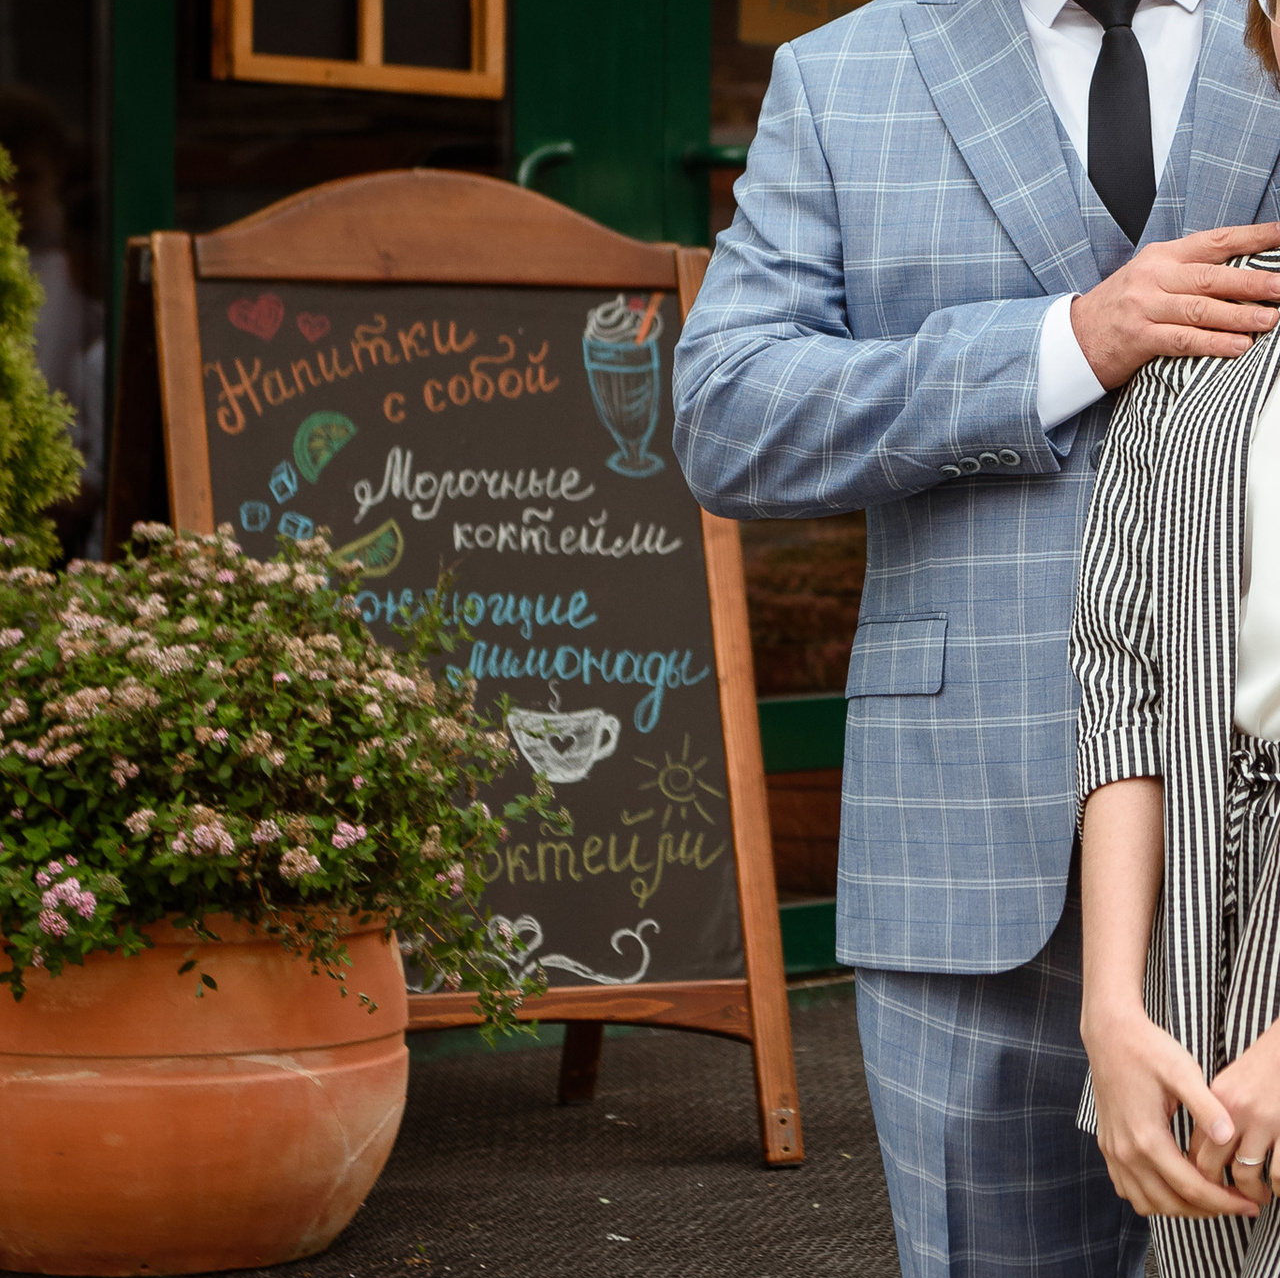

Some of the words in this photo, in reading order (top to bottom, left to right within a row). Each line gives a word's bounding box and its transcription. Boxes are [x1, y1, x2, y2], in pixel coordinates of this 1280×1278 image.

[204, 315, 476, 436] Напитки
[424, 335, 560, 414] собой
[353, 447, 595, 523] Молочные
[453, 507, 683, 557] коктейли
[472, 808, 728, 909] октейли
